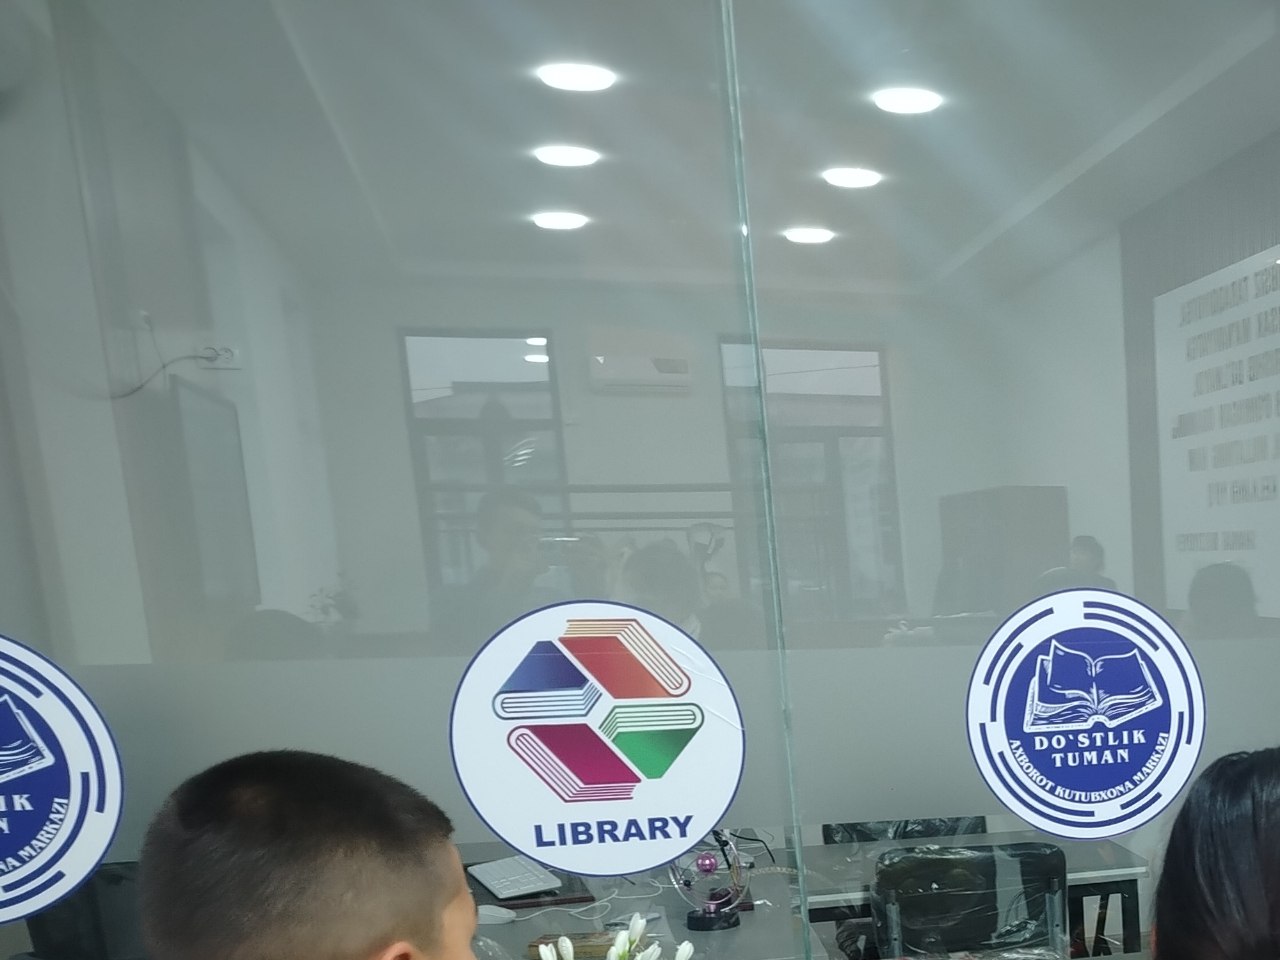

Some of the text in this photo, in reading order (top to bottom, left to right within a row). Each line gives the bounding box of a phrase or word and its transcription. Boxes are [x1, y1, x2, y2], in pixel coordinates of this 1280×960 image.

[1009, 732, 1170, 802] AXBOROT KUTUBXONA MARKAZI
[1051, 749, 1130, 767] TUMAN
[17, 797, 69, 861] MARKAZI
[533, 815, 694, 848] LIBRARY
